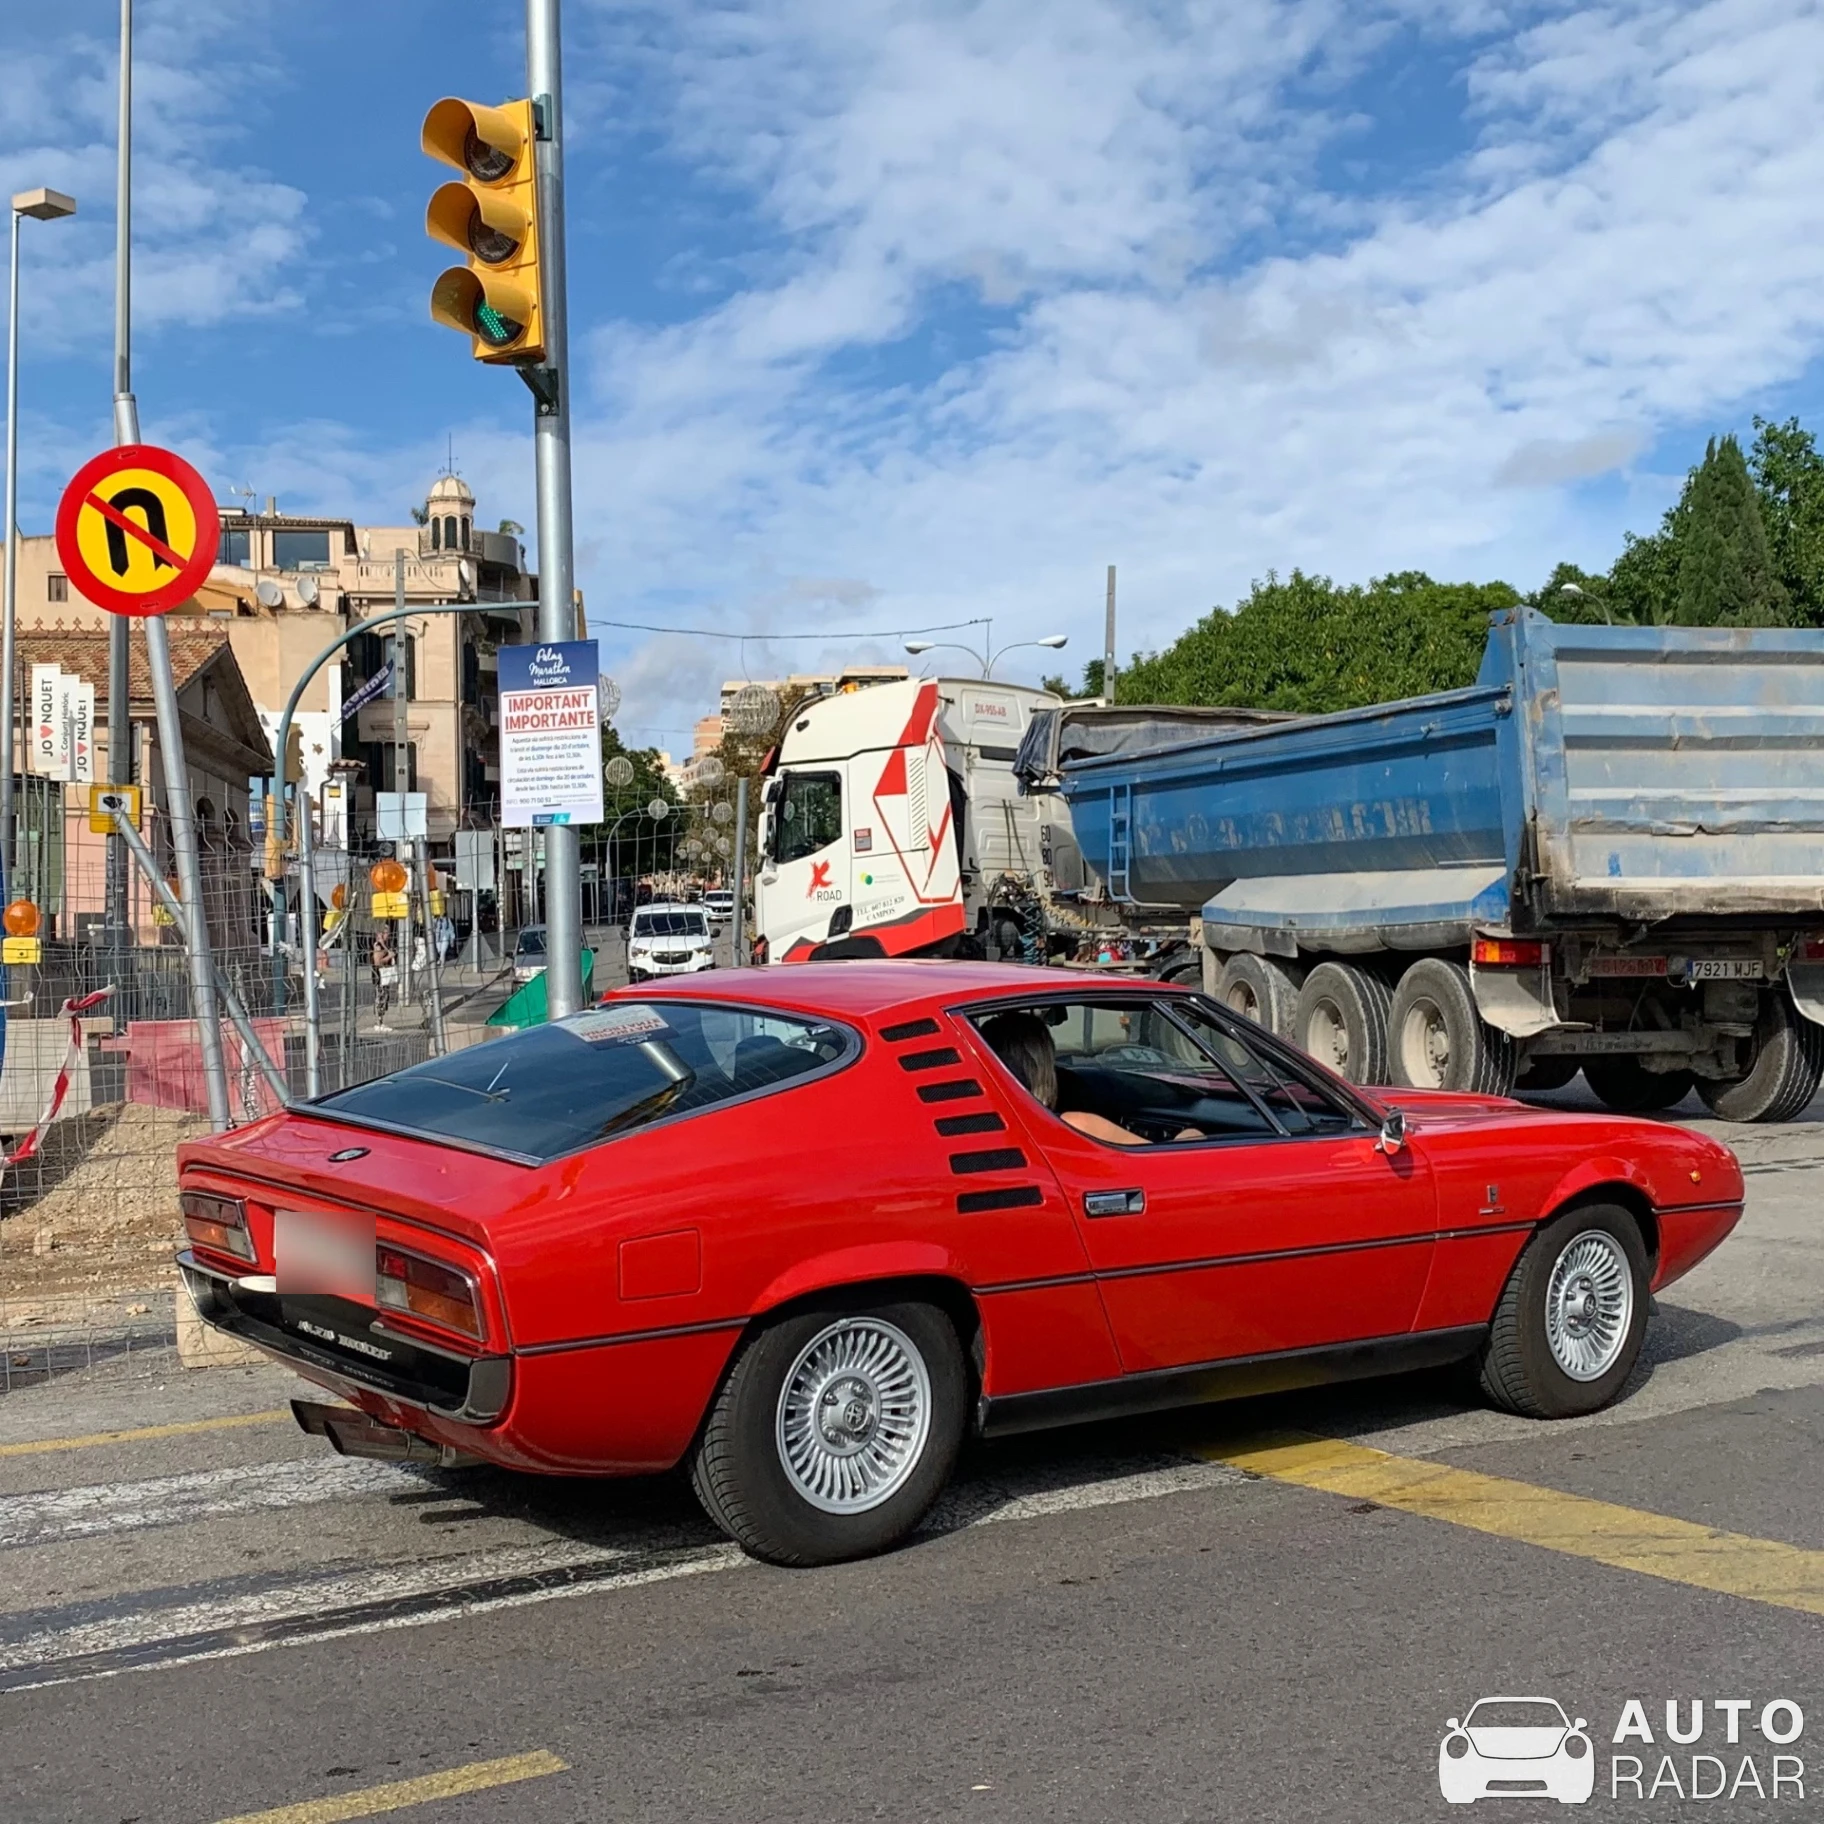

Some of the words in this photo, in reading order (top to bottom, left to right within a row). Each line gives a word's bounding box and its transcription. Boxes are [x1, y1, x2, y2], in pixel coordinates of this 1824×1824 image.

[528, 660, 571, 677] Marathon
[533, 676, 567, 686] MALLORCA
[508, 693, 590, 713] IMPORTANT
[505, 710, 595, 730] IMPORTANTE
[61, 721, 70, 750] Conjunt
[1041, 825, 1051, 842] 60
[1042, 848, 1052, 865] 80
[816, 889, 842, 902] ROAD
[866, 907, 896, 921] CAMPOS
[1695, 962, 1728, 977] 7921
[1735, 962, 1759, 977] MJF
